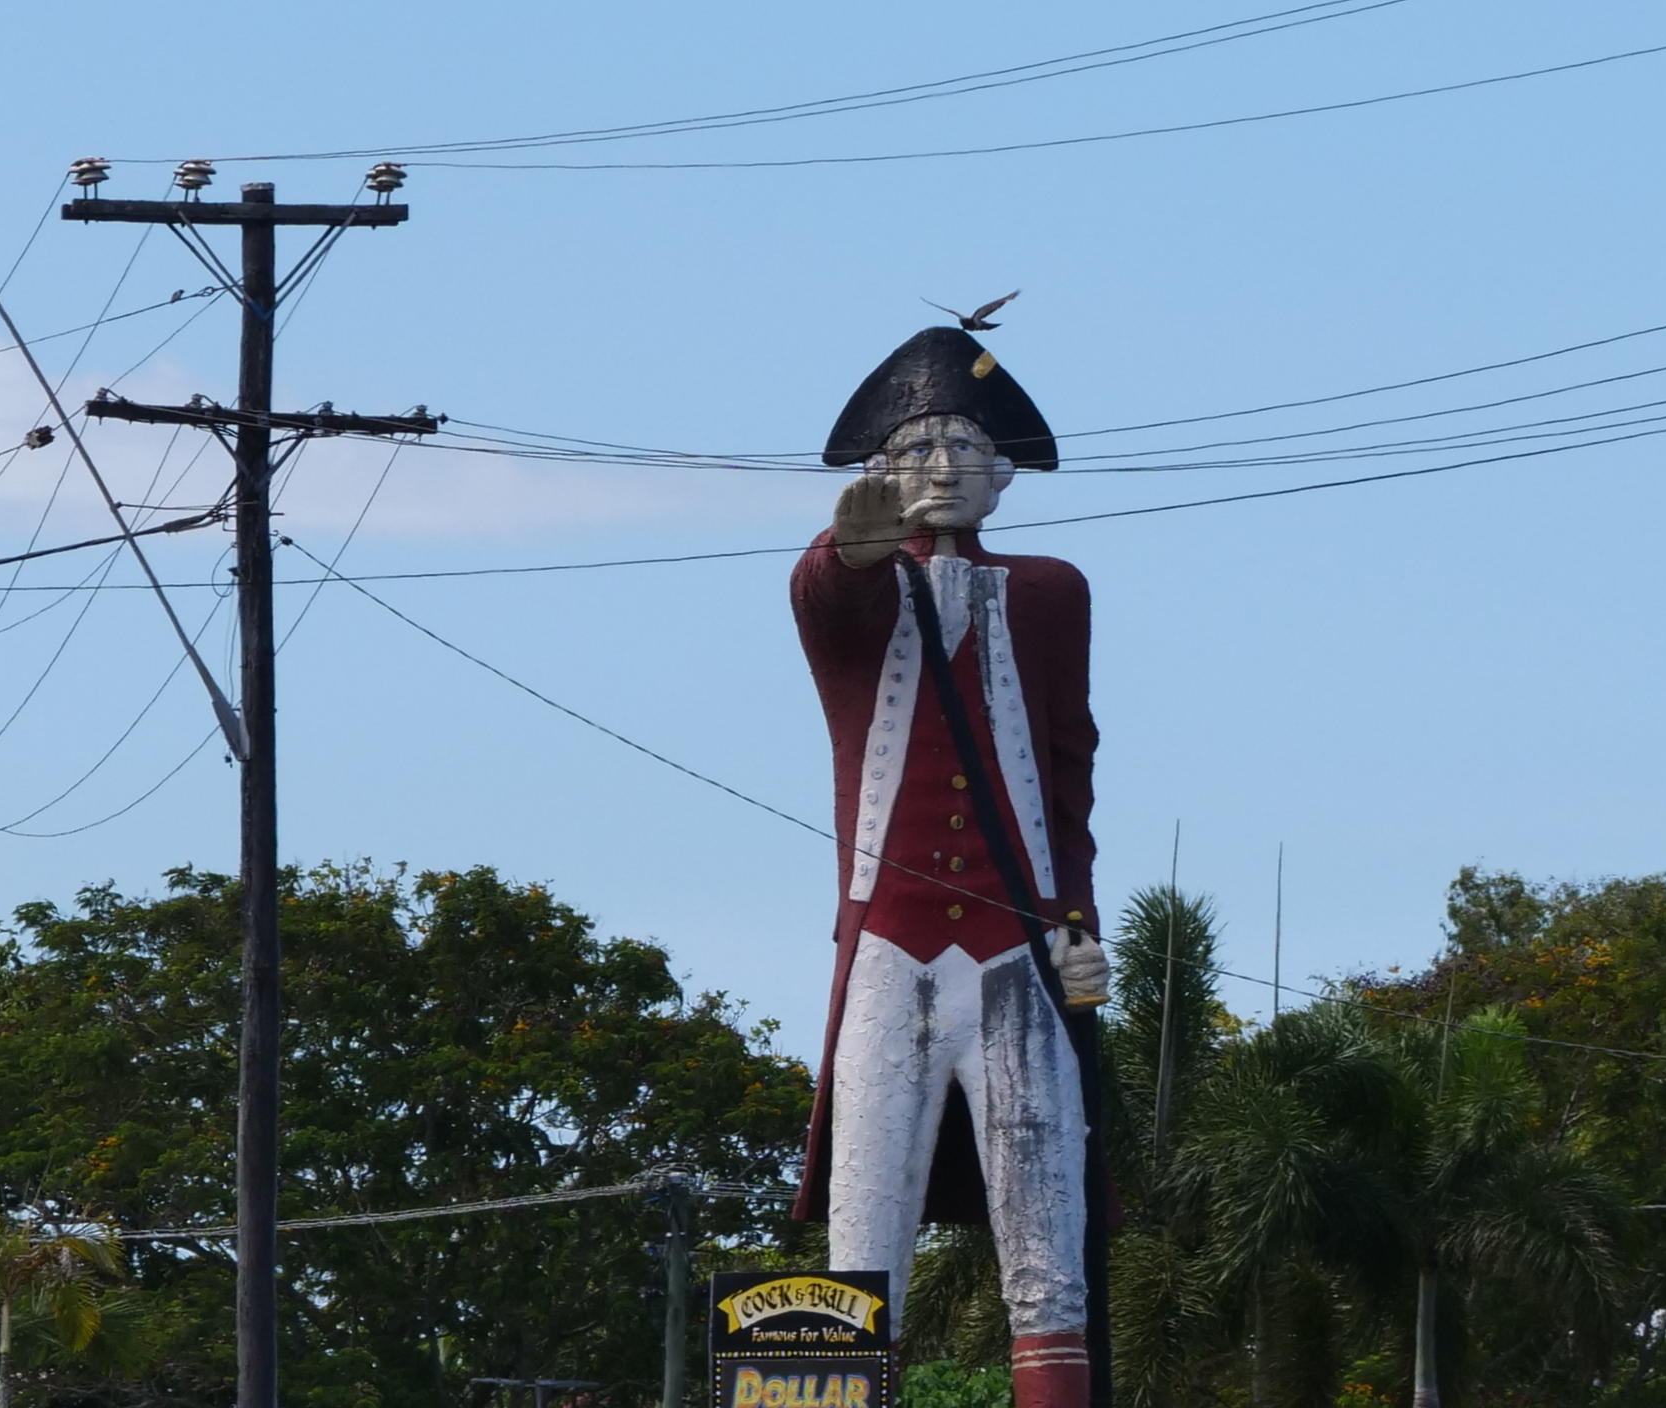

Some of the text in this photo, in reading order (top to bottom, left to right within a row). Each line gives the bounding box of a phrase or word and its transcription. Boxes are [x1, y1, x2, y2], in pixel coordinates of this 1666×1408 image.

[741, 1283, 860, 1319] COCK & BULL
[752, 1325, 857, 1343] Famous For Value
